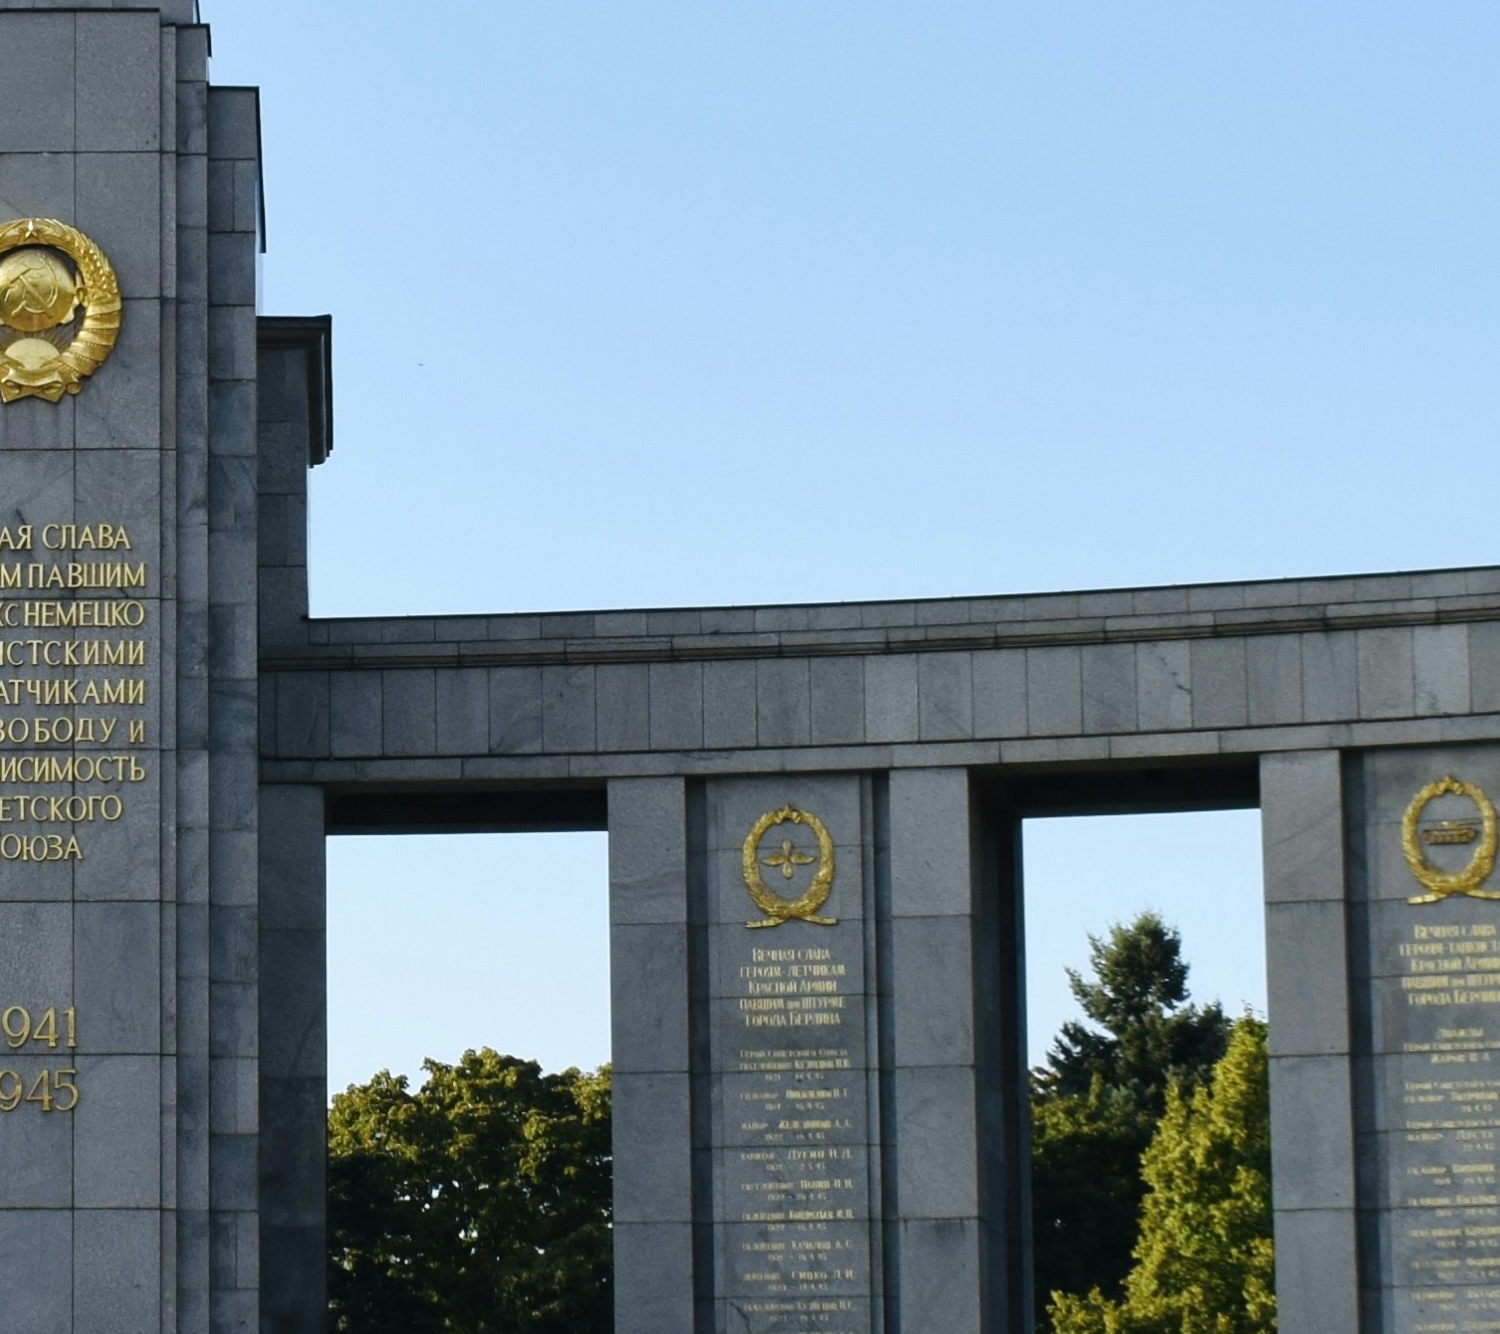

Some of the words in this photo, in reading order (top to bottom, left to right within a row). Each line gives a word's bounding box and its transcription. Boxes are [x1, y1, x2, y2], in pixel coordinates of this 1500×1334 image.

[42, 524, 132, 551] СЛАВА
[28, 563, 146, 588] ПАВШИМ
[5, 603, 18, 627] С
[24, 601, 144, 627] НЕМЕЦКО
[130, 720, 145, 743] И
